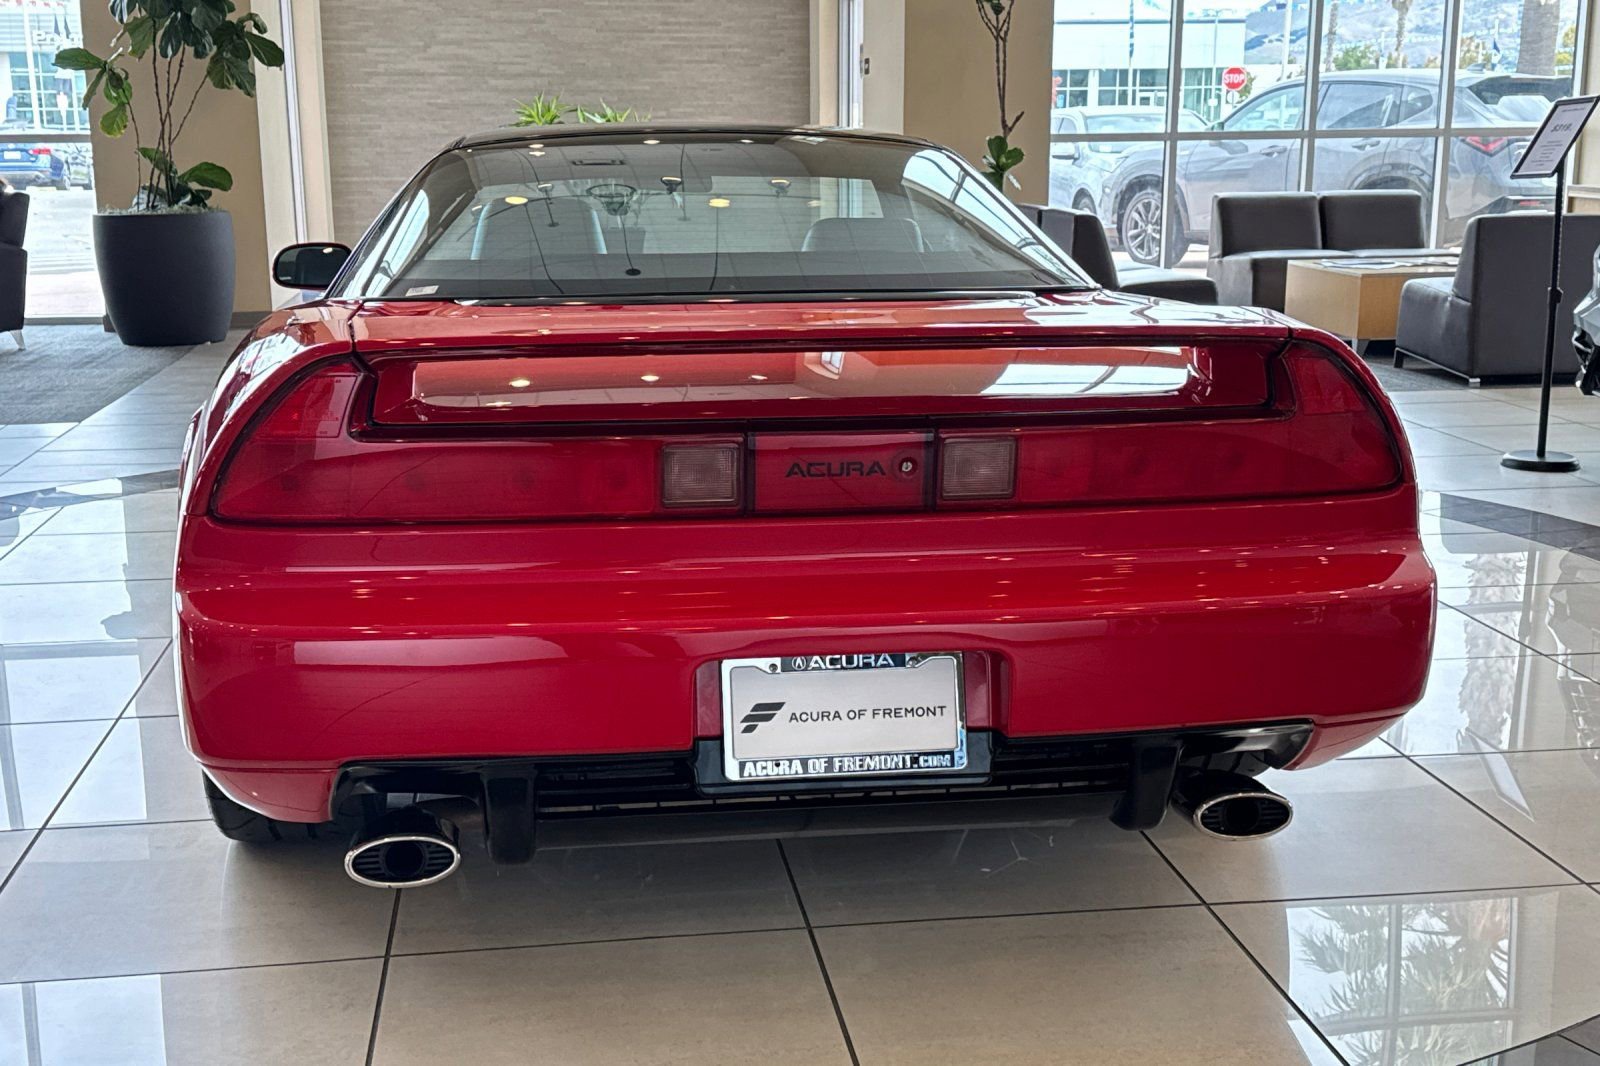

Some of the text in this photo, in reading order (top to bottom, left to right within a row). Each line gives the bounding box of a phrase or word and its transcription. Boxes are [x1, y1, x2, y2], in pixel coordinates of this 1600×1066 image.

[1224, 73, 1245, 84] STOP
[785, 461, 887, 478] ACURA
[807, 653, 895, 670] ACURA
[788, 705, 947, 723] ACURA OF FREMONT
[743, 760, 804, 777] ACURA
[807, 758, 829, 774] OF
